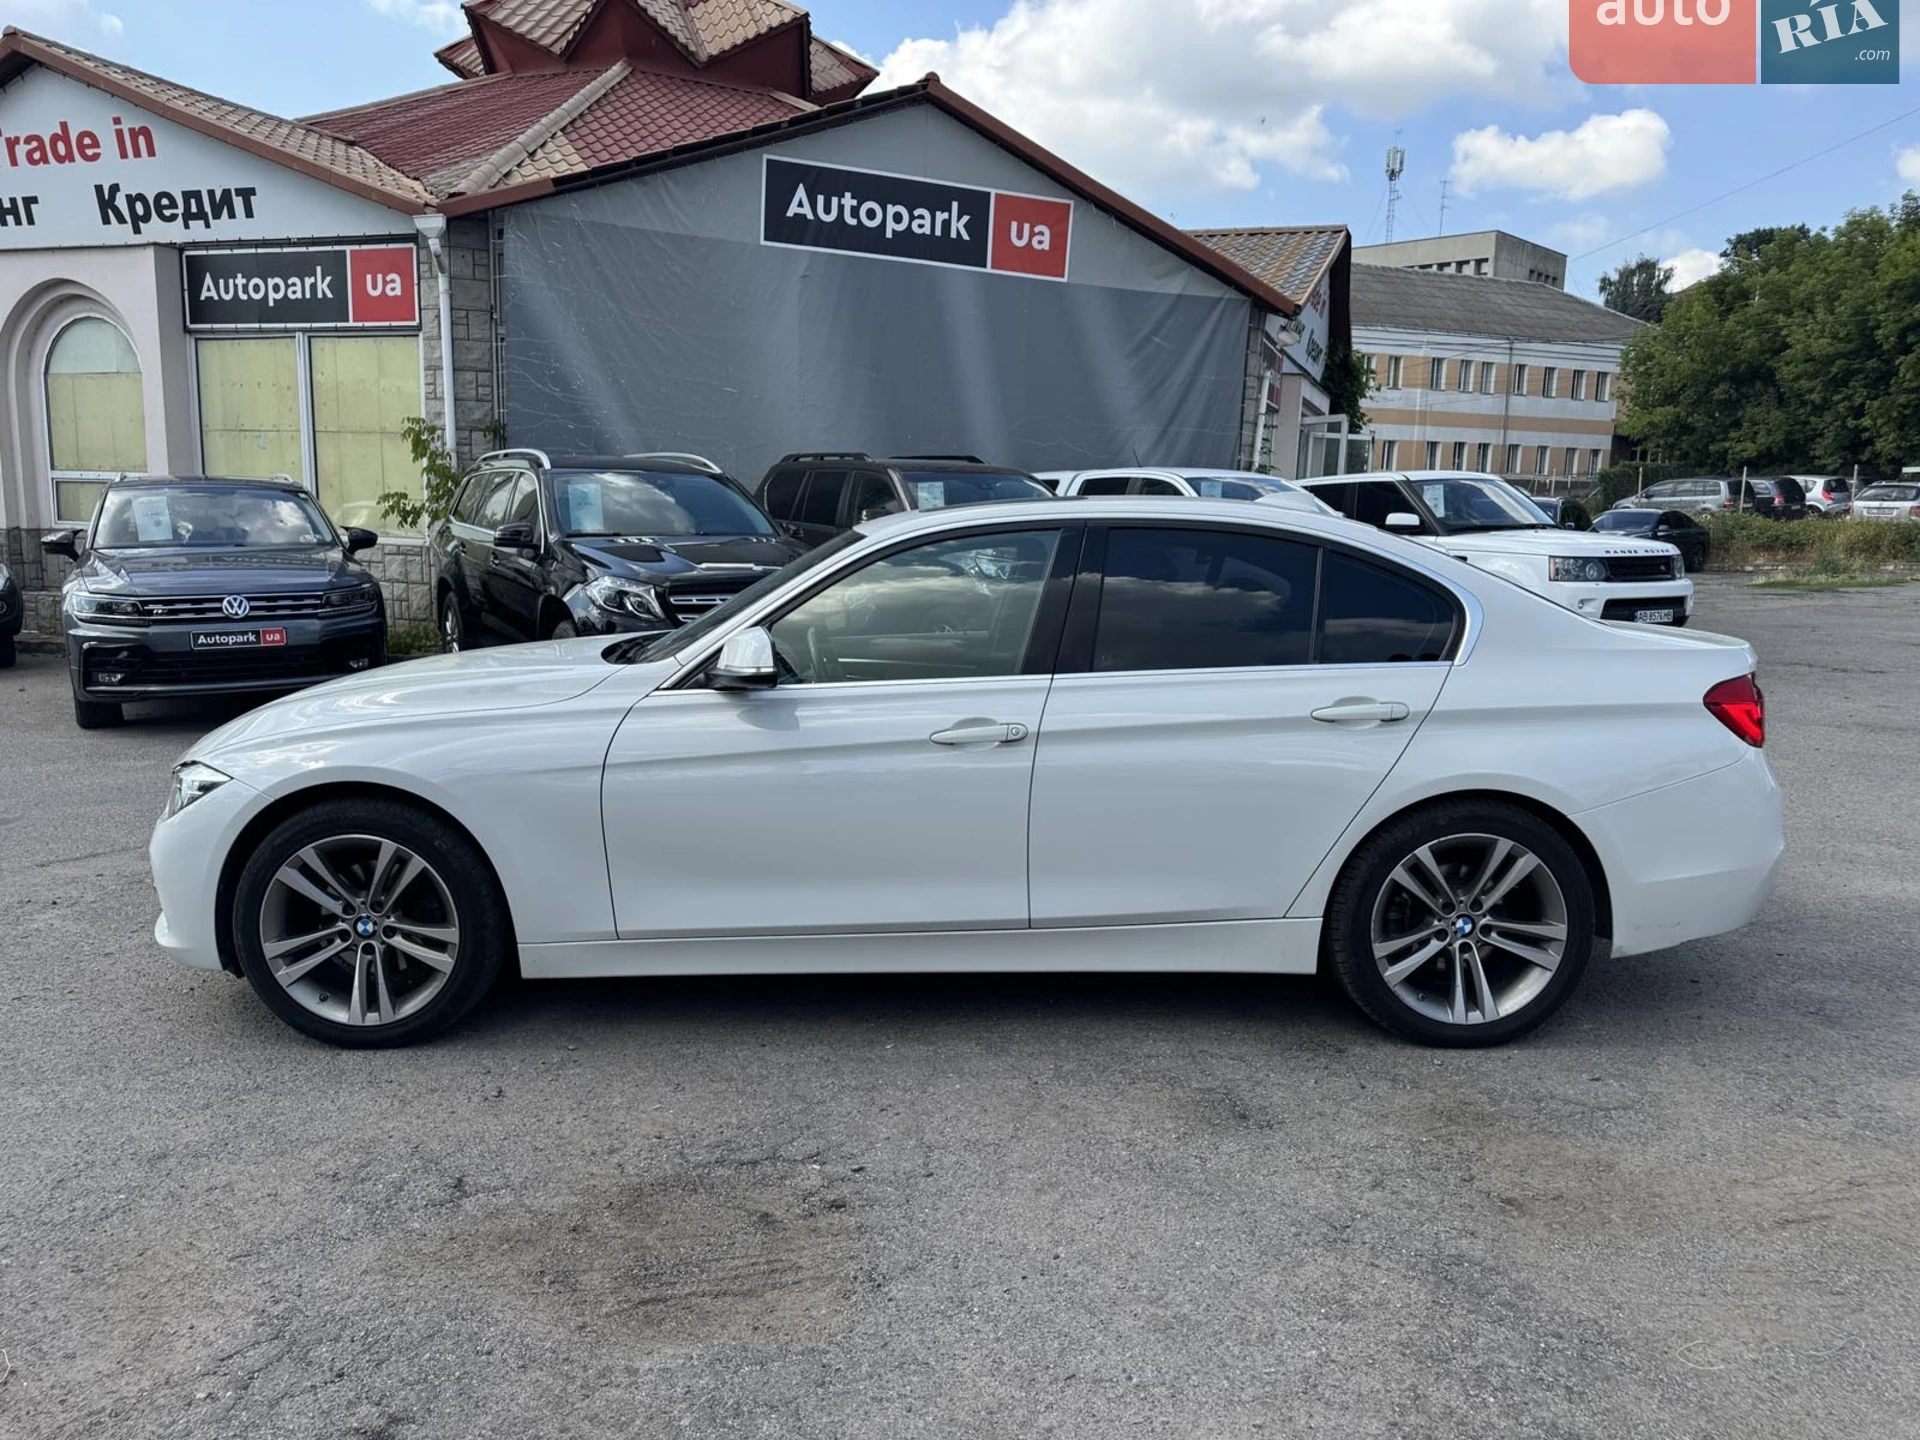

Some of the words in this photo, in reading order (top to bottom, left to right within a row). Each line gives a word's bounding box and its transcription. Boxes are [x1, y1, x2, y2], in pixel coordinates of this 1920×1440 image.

[0, 121, 101, 167] rade
[112, 117, 156, 160] in
[94, 182, 257, 235] Кредит
[785, 183, 971, 241] Autopark
[1009, 220, 1051, 251] ua
[199, 265, 334, 307] Autopark
[365, 271, 402, 298] ua
[197, 631, 257, 645] Autopark
[265, 633, 281, 642] ua
